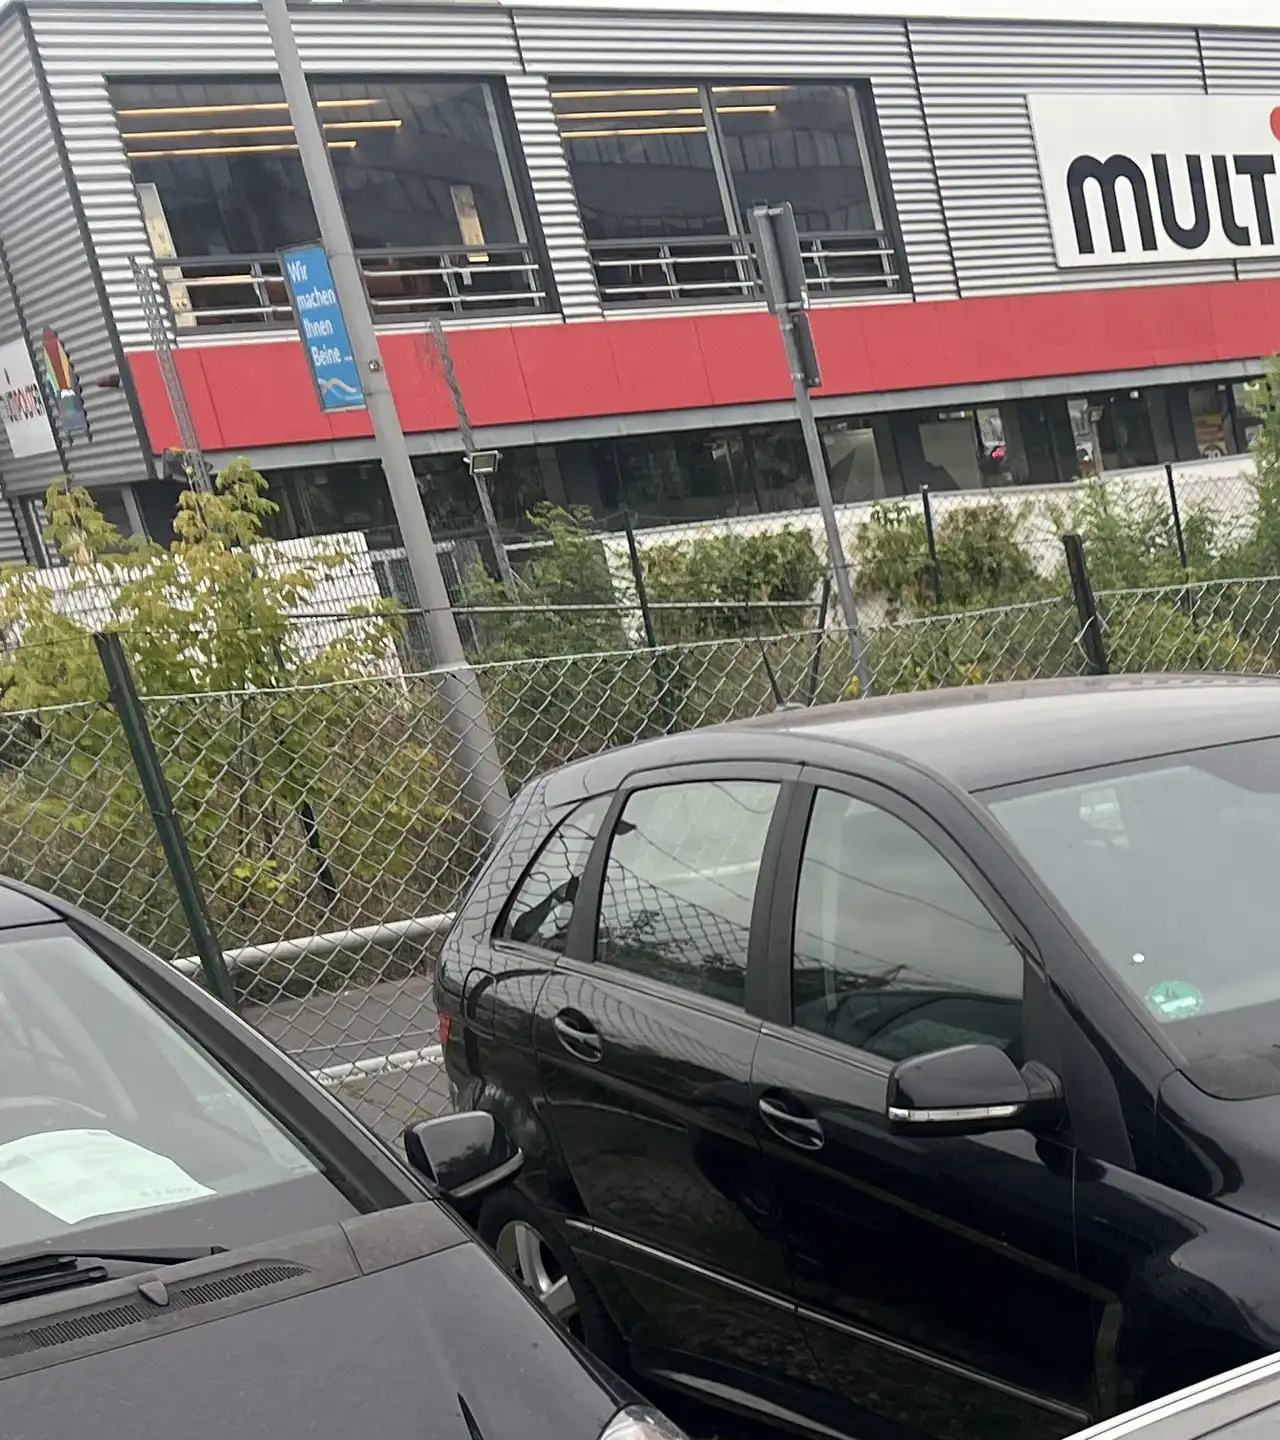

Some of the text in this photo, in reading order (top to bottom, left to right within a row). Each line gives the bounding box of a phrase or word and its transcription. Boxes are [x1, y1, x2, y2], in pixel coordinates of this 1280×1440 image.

[287, 260, 308, 283] Wir
[296, 287, 337, 311] machen
[303, 318, 334, 340] Ihnen
[310, 343, 342, 368] Beine
